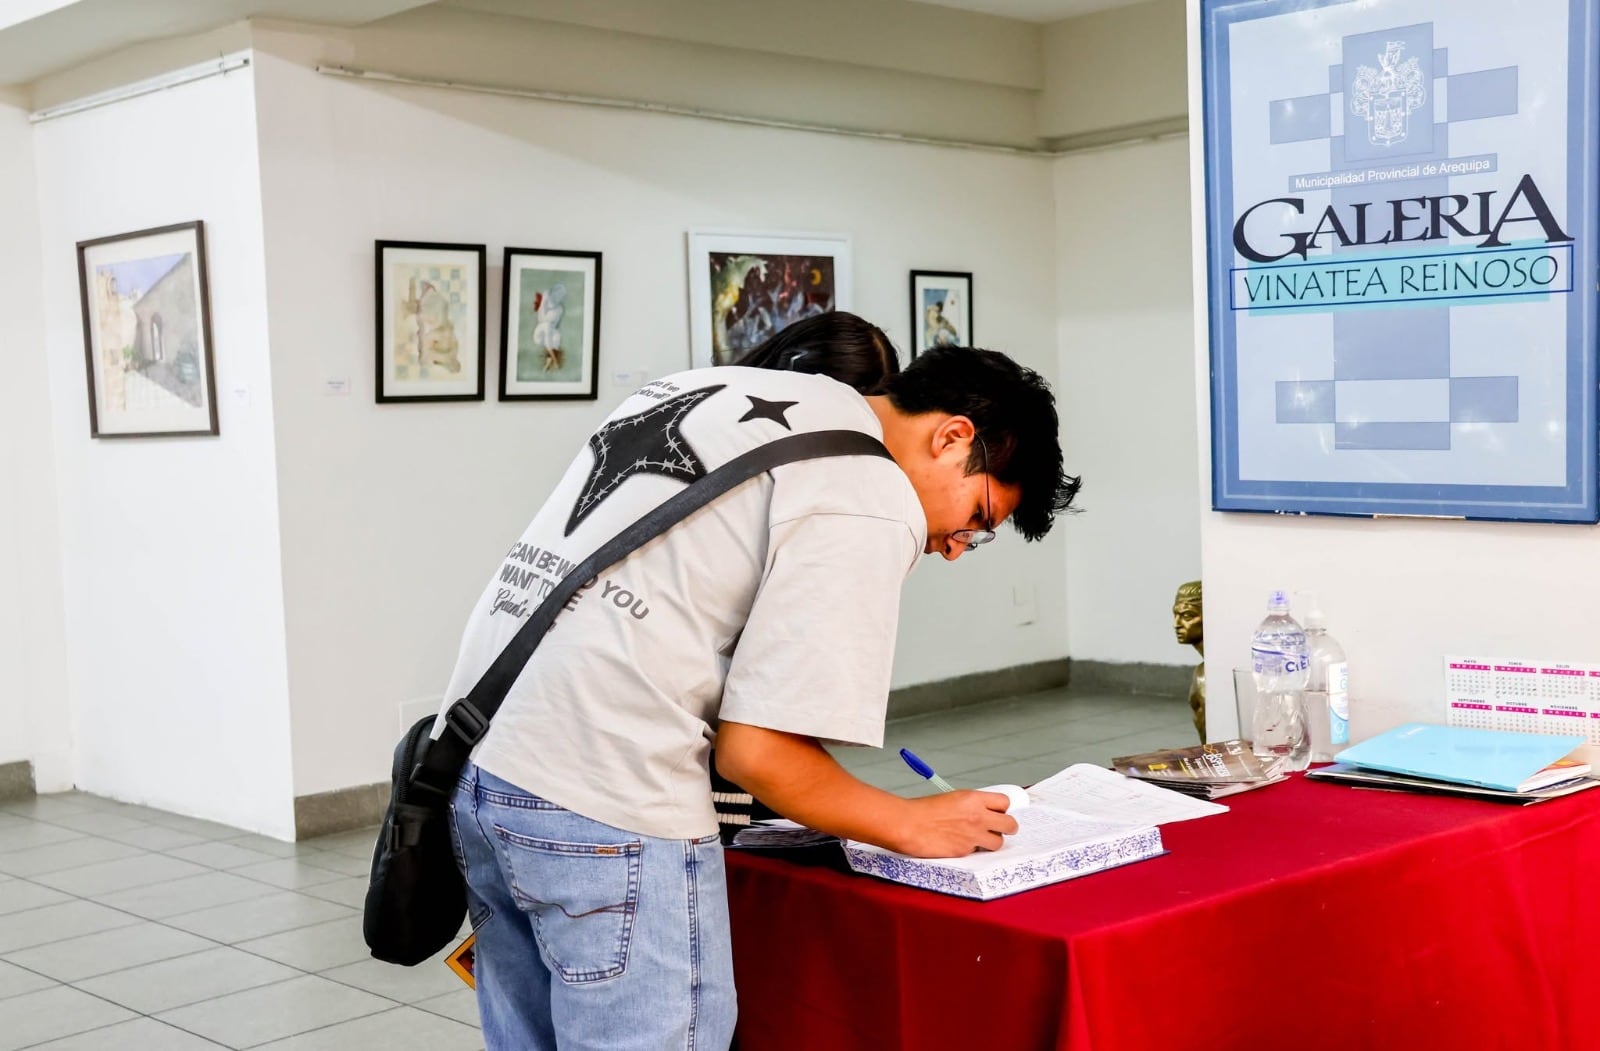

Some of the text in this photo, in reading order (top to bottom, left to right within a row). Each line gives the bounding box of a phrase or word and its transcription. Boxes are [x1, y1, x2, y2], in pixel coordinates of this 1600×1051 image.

[1295, 158, 1491, 190] Municipalidad Provincial de Arequipa
[1232, 174, 1575, 264] GALERIA
[1243, 267, 1389, 303] VINATEA
[498, 563, 540, 591] WANT
[510, 542, 541, 566] CAN
[536, 550, 560, 574] BE
[600, 580, 650, 620] YOU
